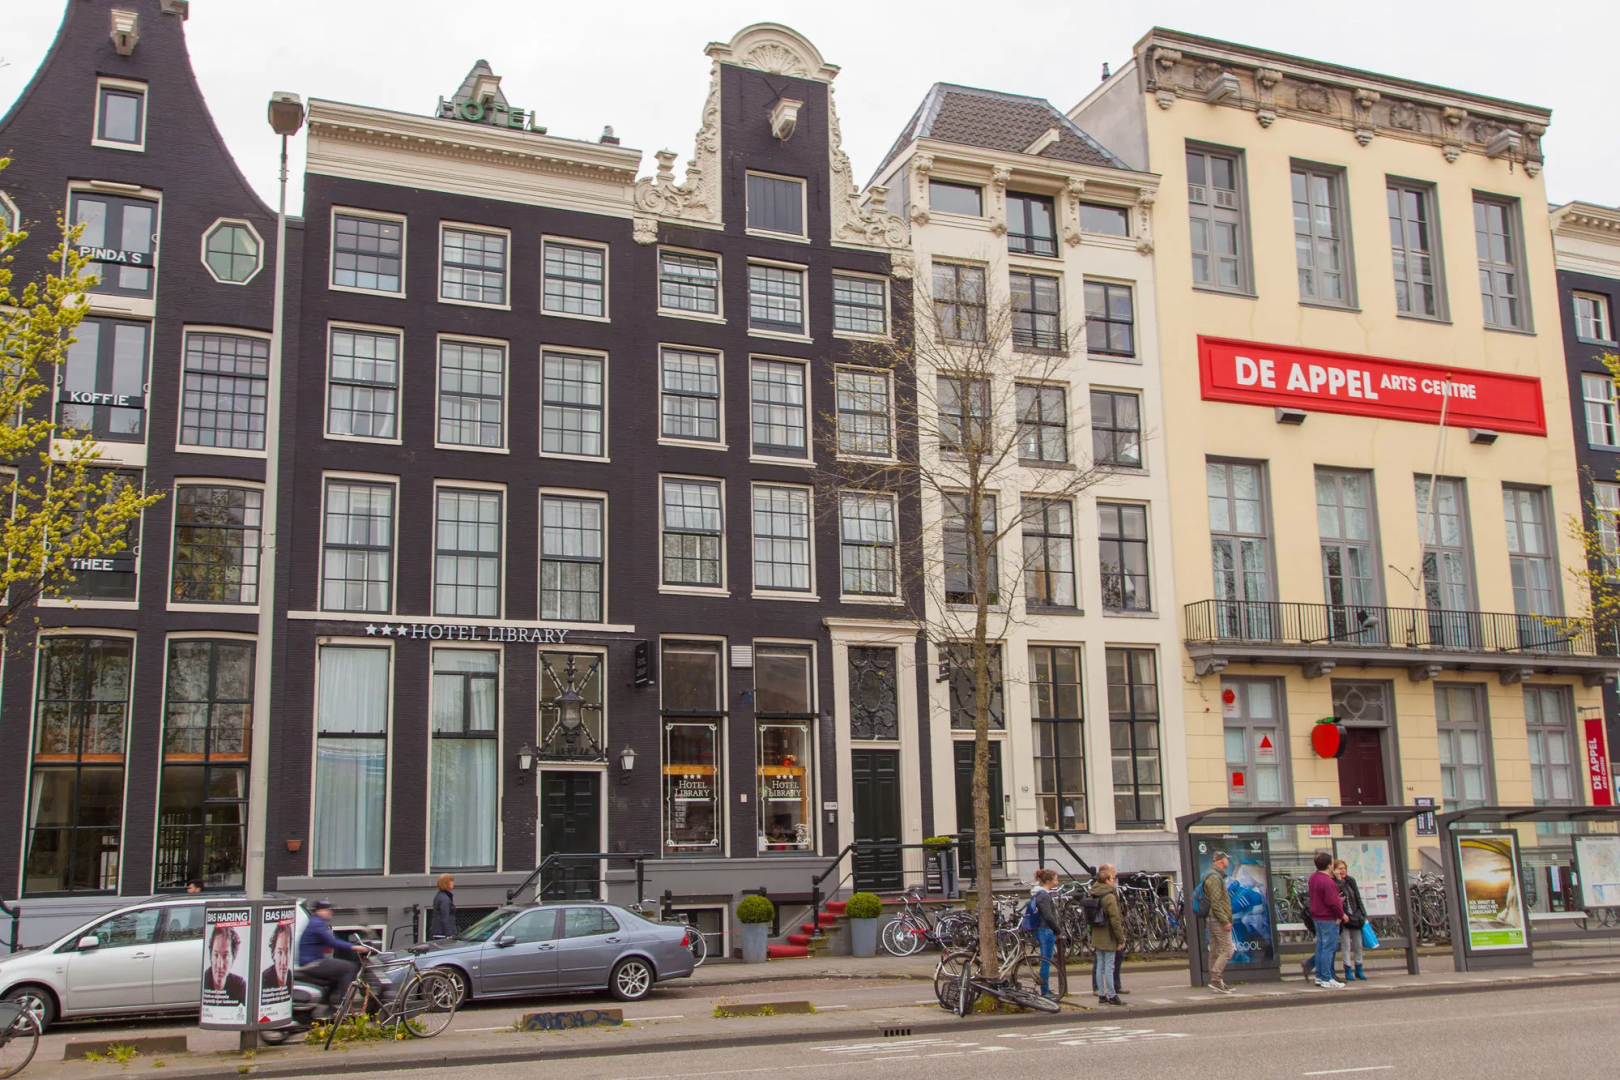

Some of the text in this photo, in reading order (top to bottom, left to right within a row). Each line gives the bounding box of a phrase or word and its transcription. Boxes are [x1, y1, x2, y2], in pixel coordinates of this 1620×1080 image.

[80, 246, 143, 264] PINDA'S
[1235, 355, 1477, 400] DE APPEL ARTS CENTRE
[70, 391, 130, 406] KOFFIE
[71, 557, 114, 571] THEE
[411, 624, 569, 644] HOTEL LIBRARY
[1588, 737, 1603, 790] DE APPEL
[679, 780, 707, 788] HOTEL
[772, 780, 799, 789] HOTEL
[675, 788, 710, 797] LIBRARY
[768, 789, 802, 797] LIBRARY
[207, 912, 248, 922] BAS HARING
[265, 911, 280, 920] BAS
